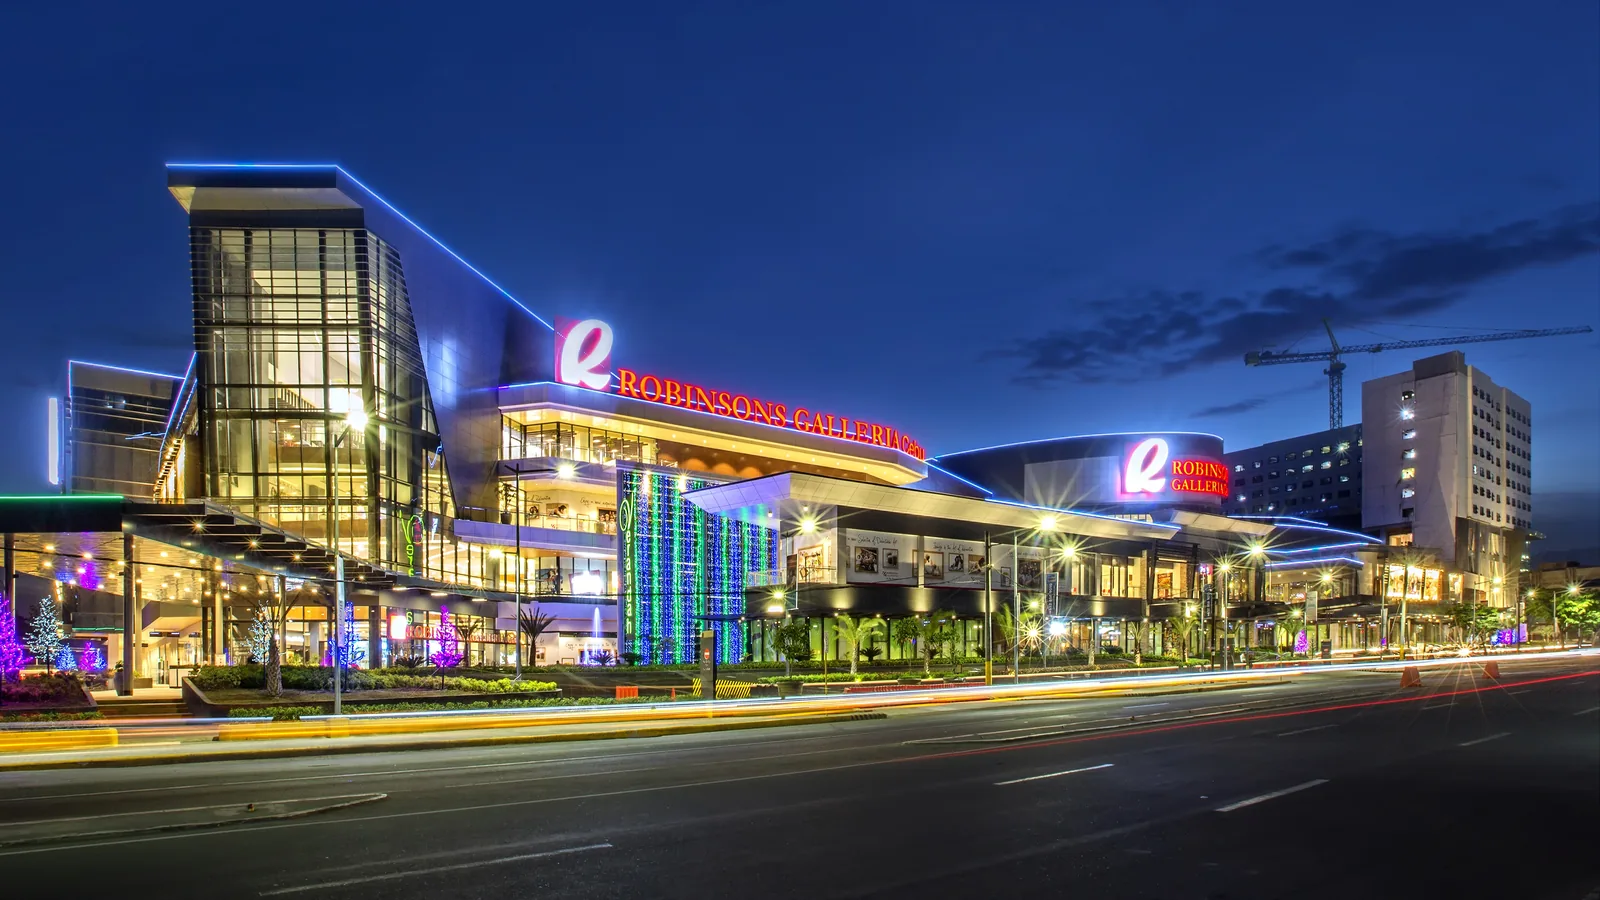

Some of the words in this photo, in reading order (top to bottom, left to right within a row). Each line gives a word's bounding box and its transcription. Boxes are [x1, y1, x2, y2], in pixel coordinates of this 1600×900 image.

[618, 368, 786, 427] ROBINSONS
[793, 408, 900, 449] GALLERIA
[901, 435, 925, 461] Cebu
